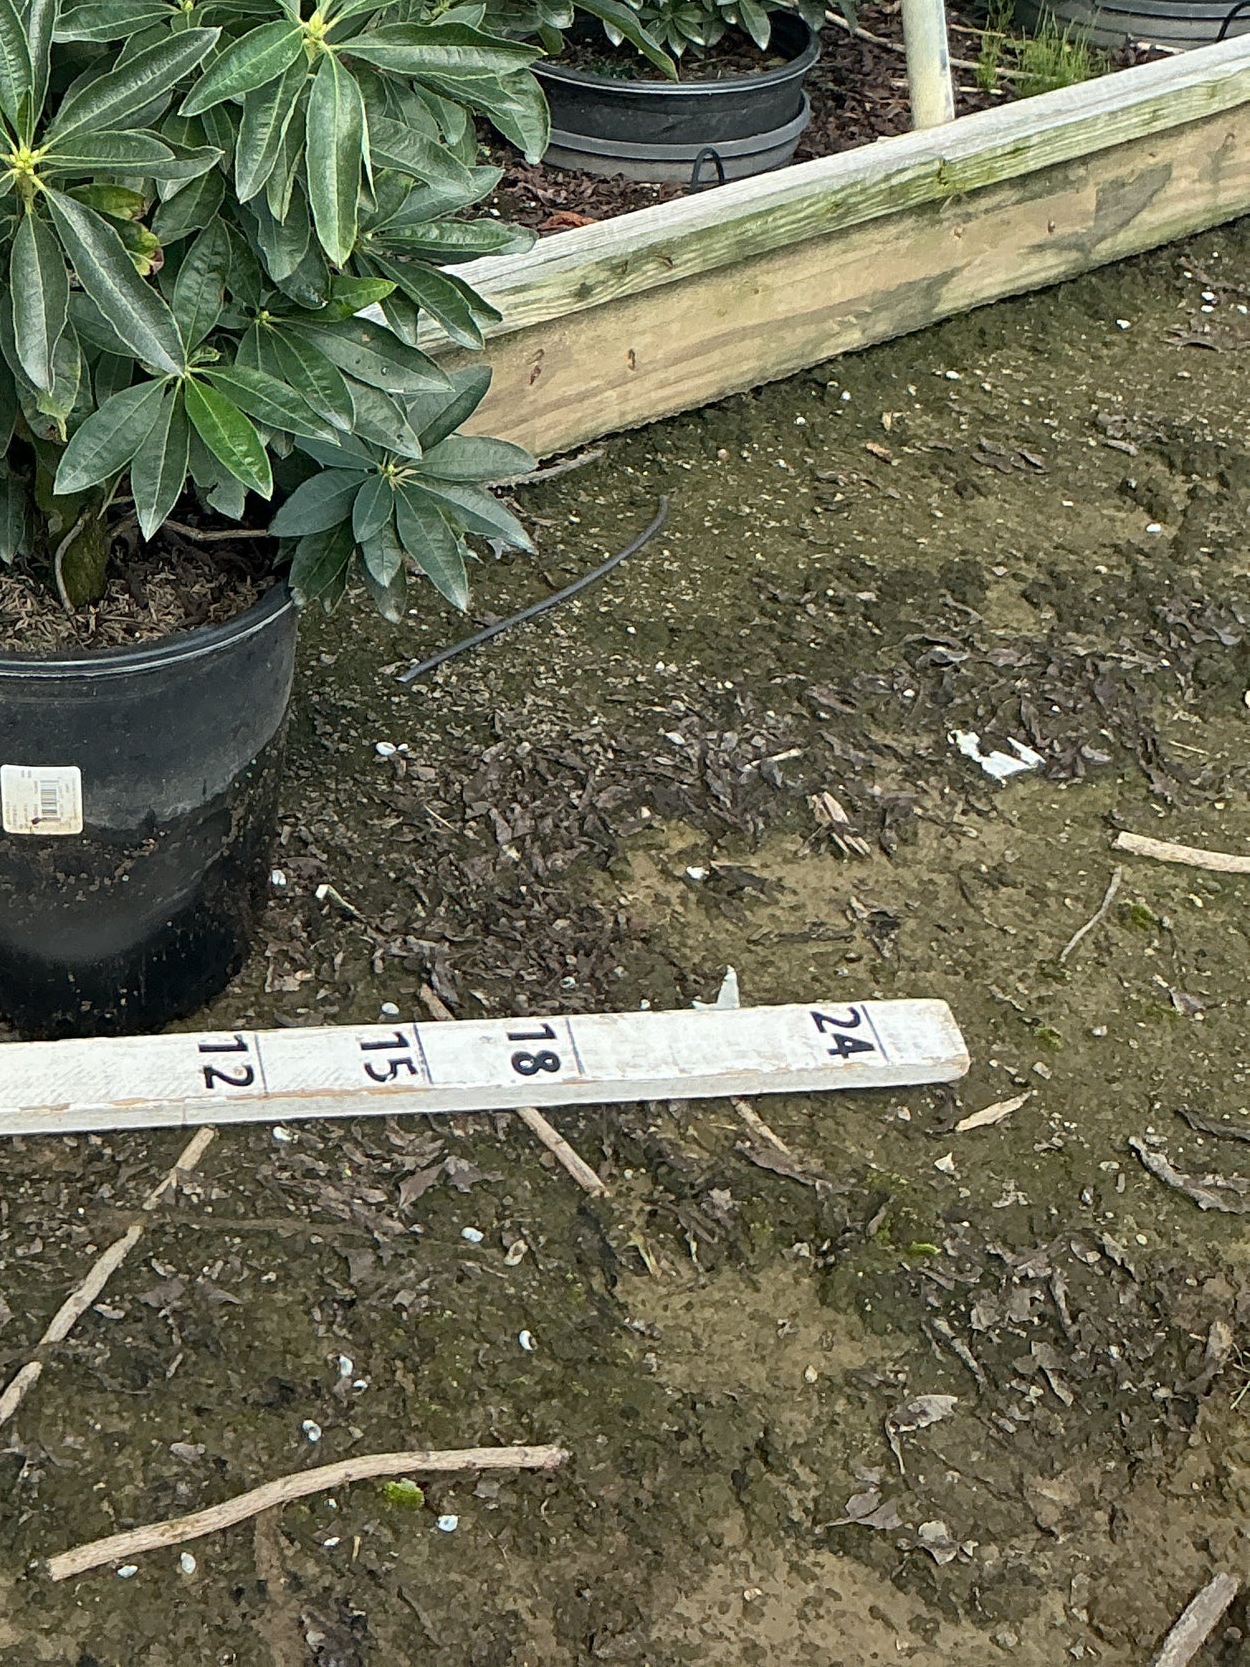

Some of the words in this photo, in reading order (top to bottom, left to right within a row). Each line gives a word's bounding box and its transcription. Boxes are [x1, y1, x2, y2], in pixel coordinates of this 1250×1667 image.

[358, 1030, 420, 1084] 15
[506, 1022, 562, 1077] 18
[808, 1006, 876, 1061] 24
[197, 1033, 255, 1091] 12
